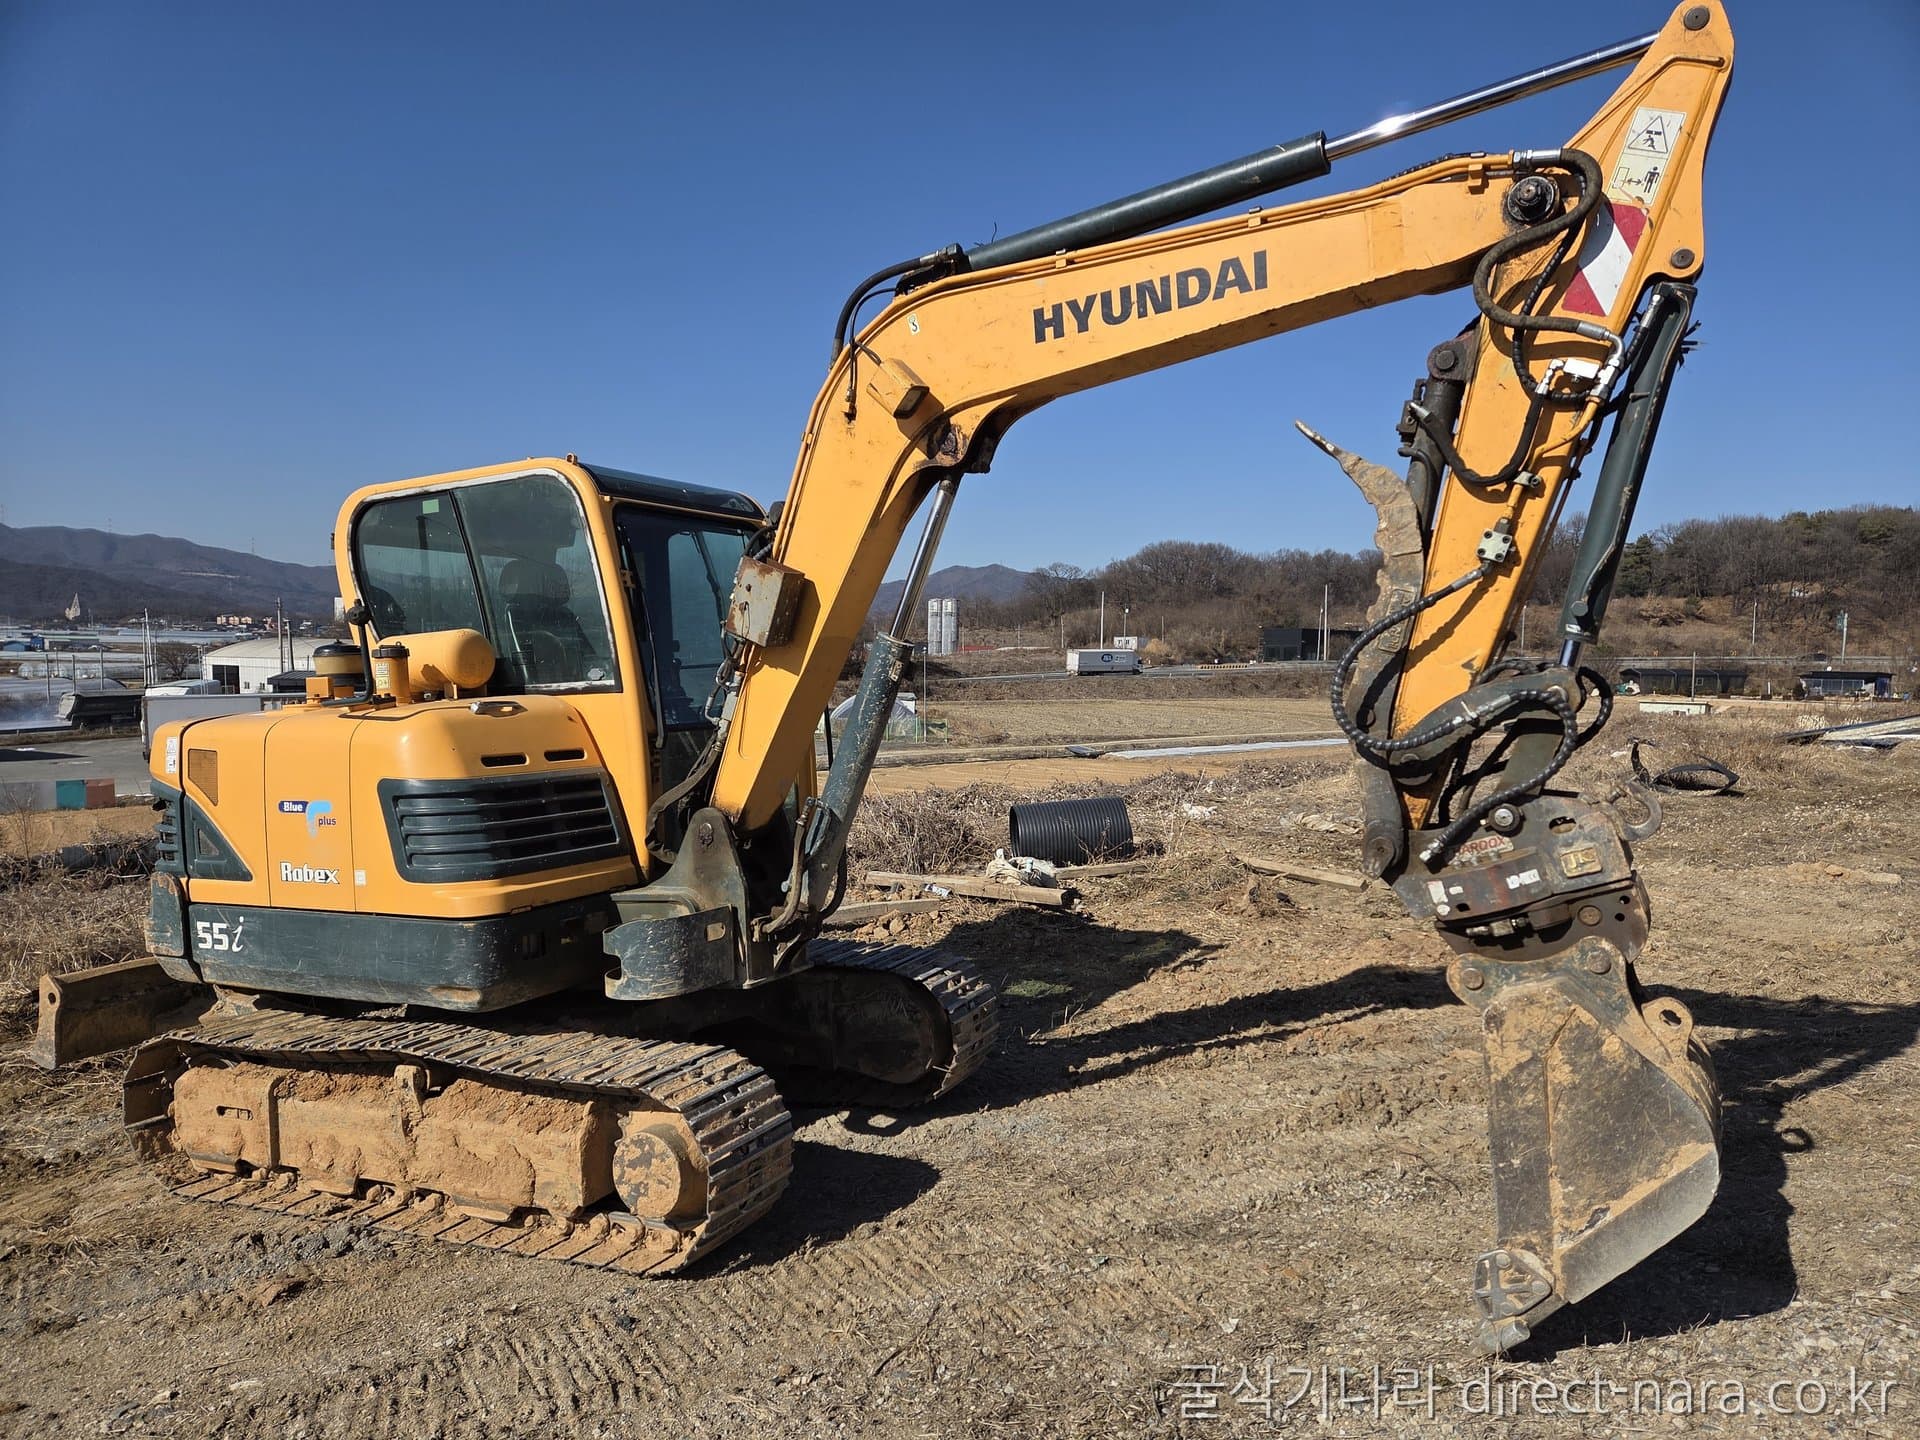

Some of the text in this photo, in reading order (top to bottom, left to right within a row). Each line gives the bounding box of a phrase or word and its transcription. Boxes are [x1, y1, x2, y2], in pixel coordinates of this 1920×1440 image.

[1033, 249, 1268, 344] HYUNDAI
[283, 801, 304, 812] Blue
[318, 815, 337, 827] plus
[1456, 835, 1506, 855] ARDOX
[280, 861, 340, 884] Robex
[196, 915, 245, 953] 55i
